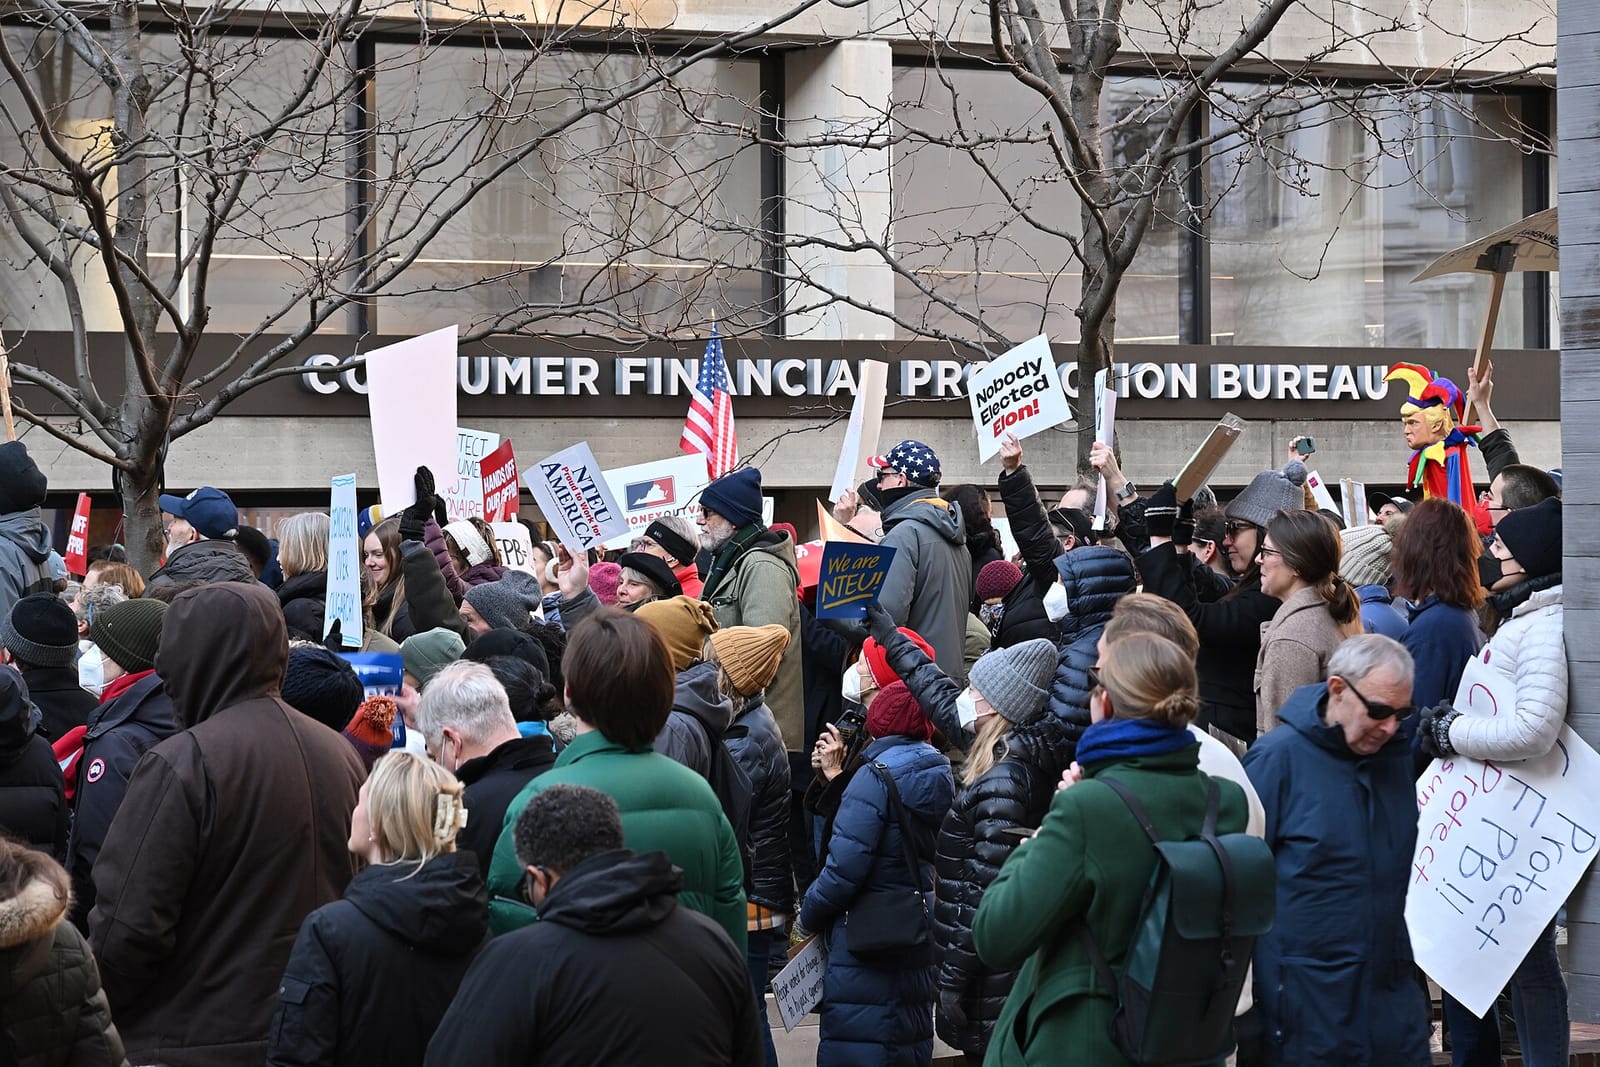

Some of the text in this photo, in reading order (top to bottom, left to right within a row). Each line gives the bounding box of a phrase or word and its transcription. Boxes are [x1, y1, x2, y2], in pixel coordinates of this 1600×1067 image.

[301, 353, 1389, 400] COUMER FINNCIA PRCION BUREAU
[976, 356, 1042, 408] Nobody
[980, 373, 1050, 426] Elected
[992, 398, 1040, 438] Elon!
[458, 433, 488, 457] TECT
[483, 466, 506, 495] HANDS
[504, 458, 515, 480] OFF
[571, 465, 613, 523] NTEU
[486, 491, 501, 514] OUR
[540, 462, 594, 548] AMERICA
[561, 466, 602, 537] Proud to Work for
[66, 534, 84, 556] FPB!
[829, 553, 880, 575] We are
[822, 571, 884, 603] NTEU!
[1475, 811, 1597, 950] Protect
